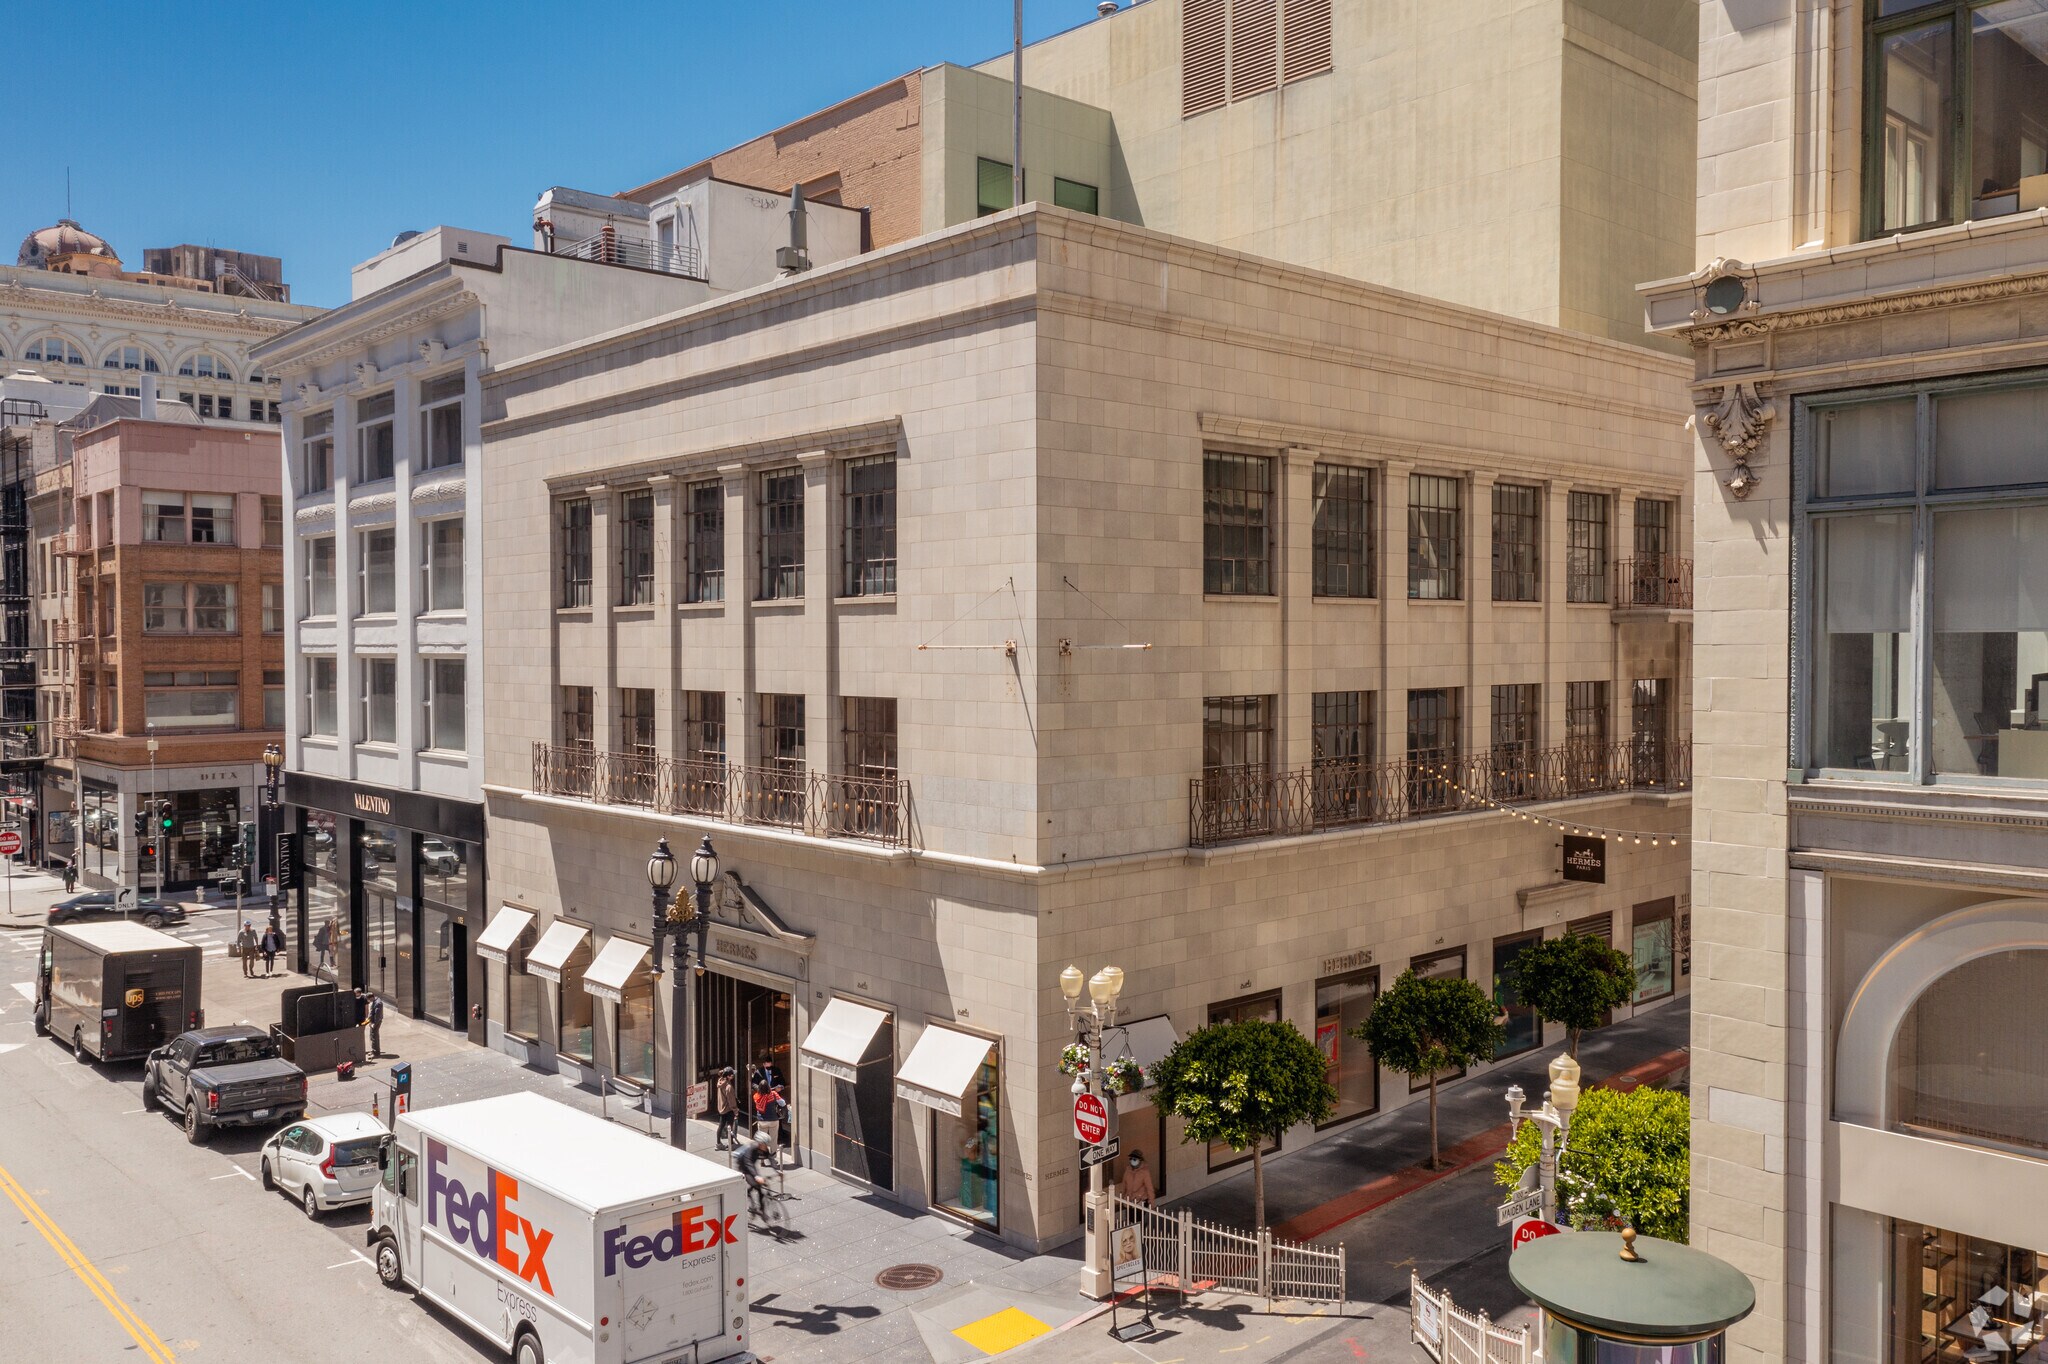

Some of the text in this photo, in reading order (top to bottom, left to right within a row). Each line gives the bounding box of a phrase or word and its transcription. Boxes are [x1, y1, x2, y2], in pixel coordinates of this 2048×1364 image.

[201, 772, 237, 780] DITA
[354, 792, 390, 815] VALENTINO
[280, 838, 290, 886] VALENTINO
[1567, 856, 1601, 867] HERMÈS
[716, 940, 758, 961] HERMÈS
[221, 1083, 300, 1100] FORD
[1078, 1100, 1103, 1115] DO NOT
[1081, 1122, 1101, 1136] ENTER
[1092, 1143, 1116, 1160] ONE WAY
[1501, 1195, 1541, 1220] MAIDEN LANE
[427, 1137, 555, 1297] FedEx
[603, 1205, 739, 1277] FedEx
[1522, 1228, 1536, 1240] DO
[682, 1253, 717, 1270] Express
[682, 1274, 714, 1289] fedex.com
[497, 1279, 538, 1323] Express
